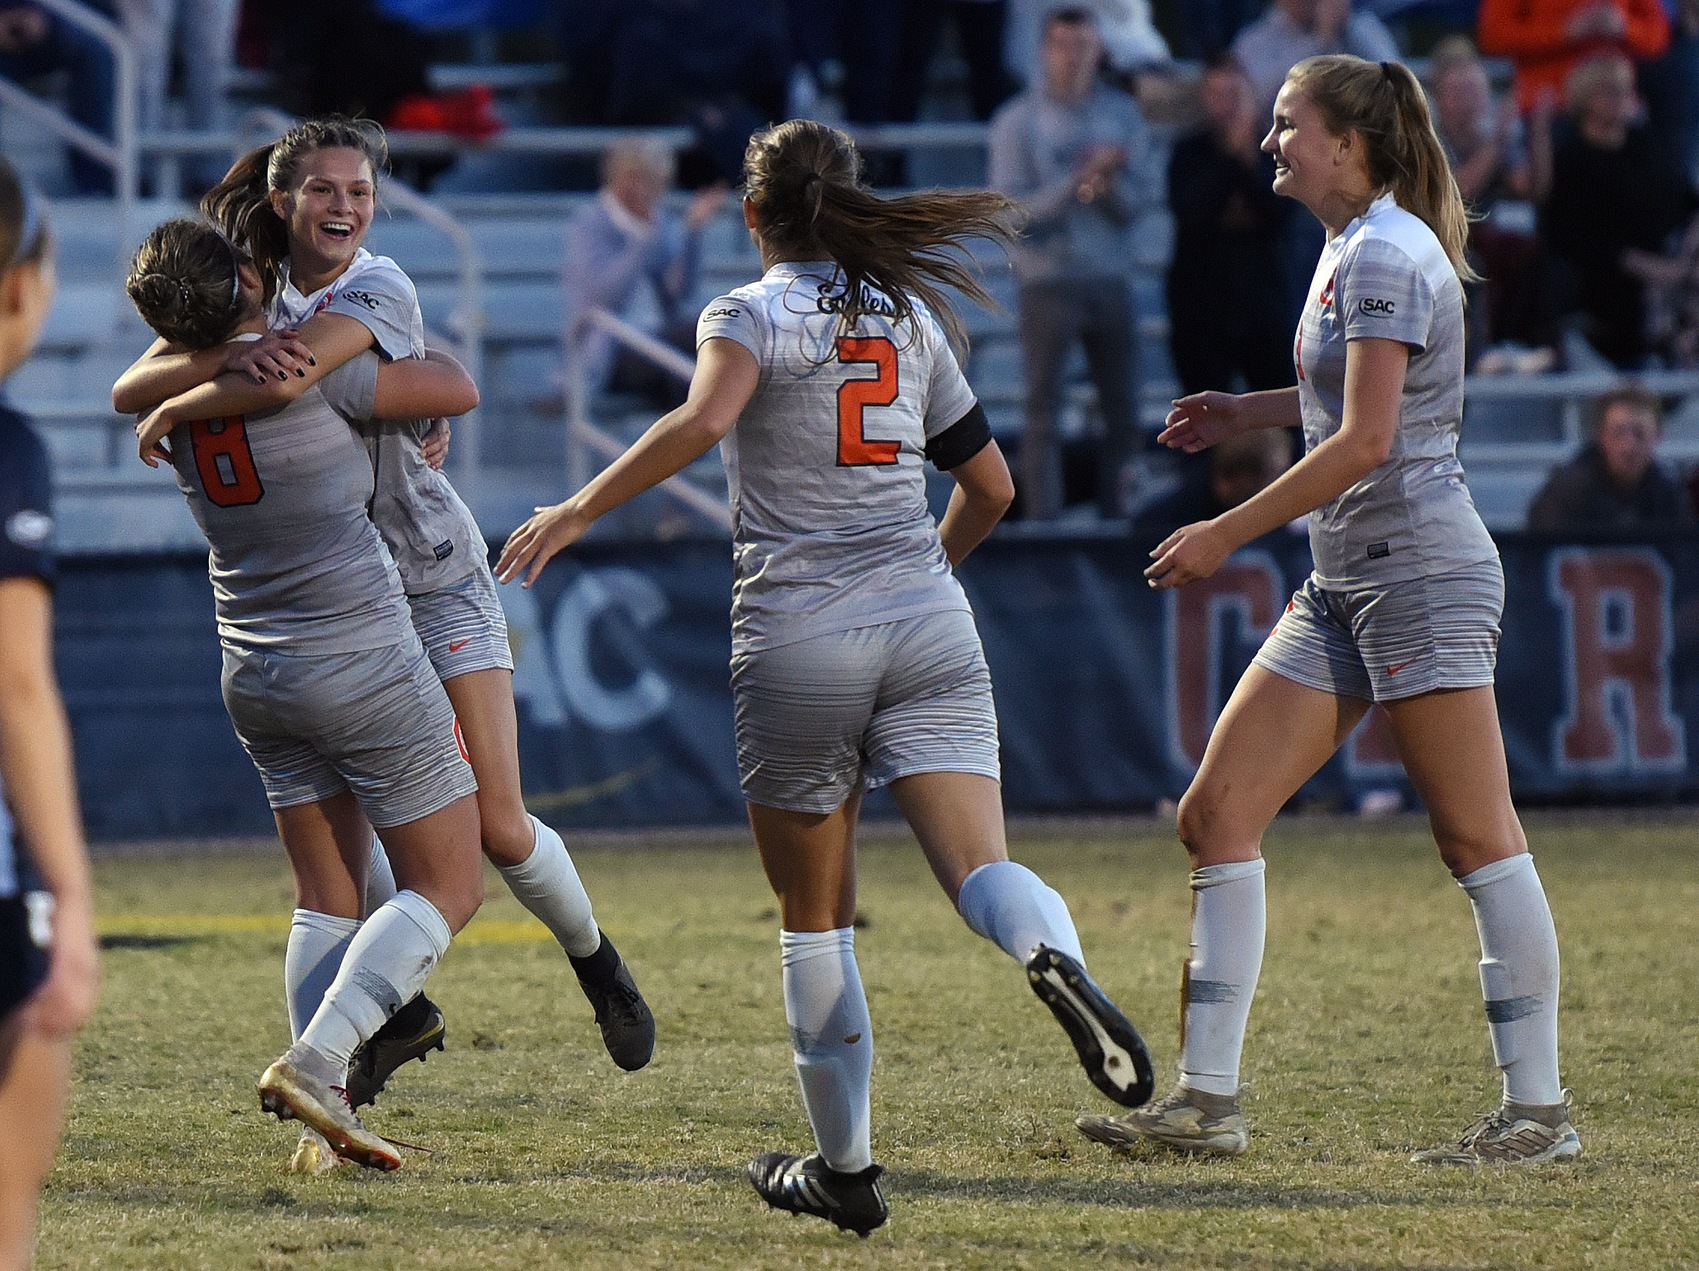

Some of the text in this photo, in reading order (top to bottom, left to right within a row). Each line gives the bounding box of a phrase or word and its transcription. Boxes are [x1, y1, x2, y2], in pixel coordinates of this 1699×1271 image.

[346, 291, 380, 310] SAC
[706, 308, 741, 319] SAC
[817, 283, 897, 318] Eales
[1363, 298, 1395, 314] SAC
[836, 336, 902, 467] 2
[188, 414, 266, 508] 8
